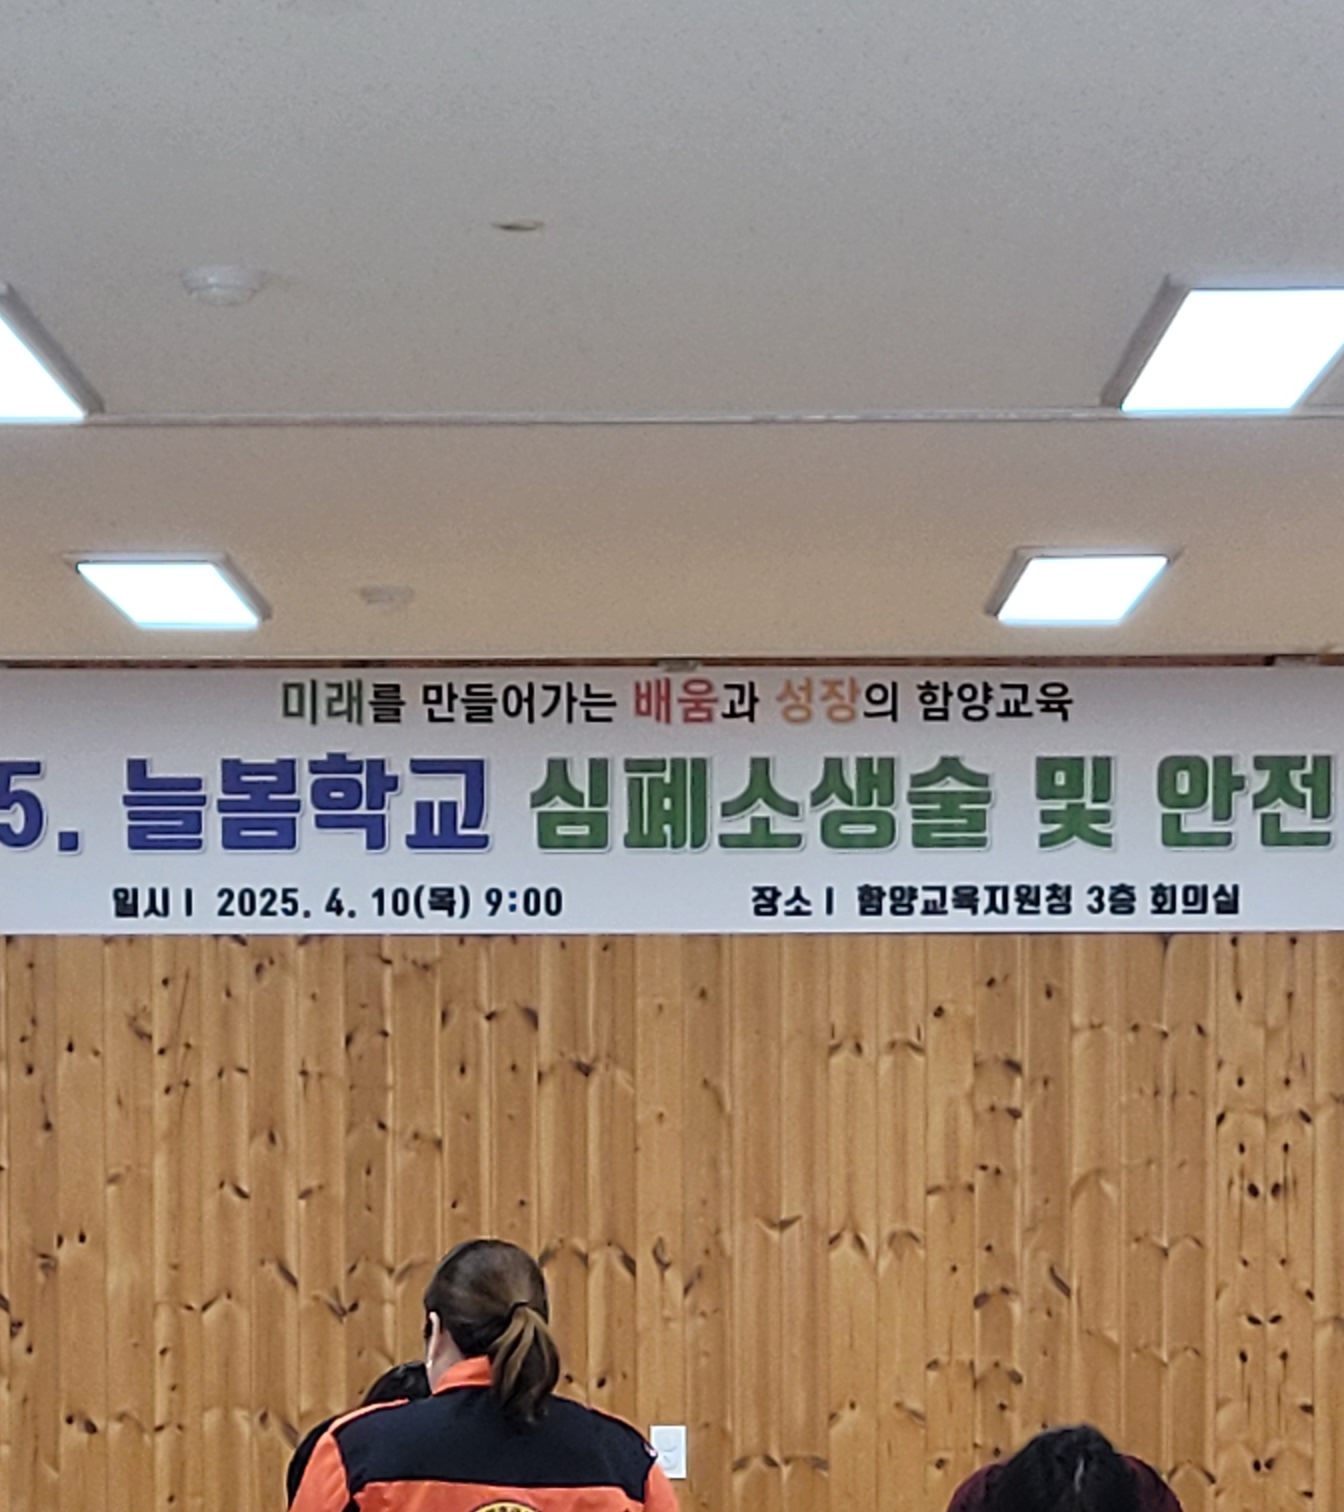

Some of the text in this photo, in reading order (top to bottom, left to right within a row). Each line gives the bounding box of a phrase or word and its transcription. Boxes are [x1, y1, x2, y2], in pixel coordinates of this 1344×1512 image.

[282, 677, 1073, 725] 미래를 만들어가는 배움과 성장의 함양교육
[122, 753, 490, 852] 늘봄학교
[529, 756, 992, 851] 심폐소생술
[1033, 755, 1114, 849] 및
[1157, 755, 1335, 848] 안전
[112, 887, 170, 919] 일시
[217, 887, 312, 919] 2025.
[324, 887, 357, 919] 4.
[371, 885, 471, 919] 10(목)
[485, 887, 564, 918] 9:00
[752, 885, 813, 916] 장소
[857, 884, 1073, 916] 함양교육지원청
[1086, 884, 1137, 915] 3층
[1150, 884, 1240, 916] 회의실
